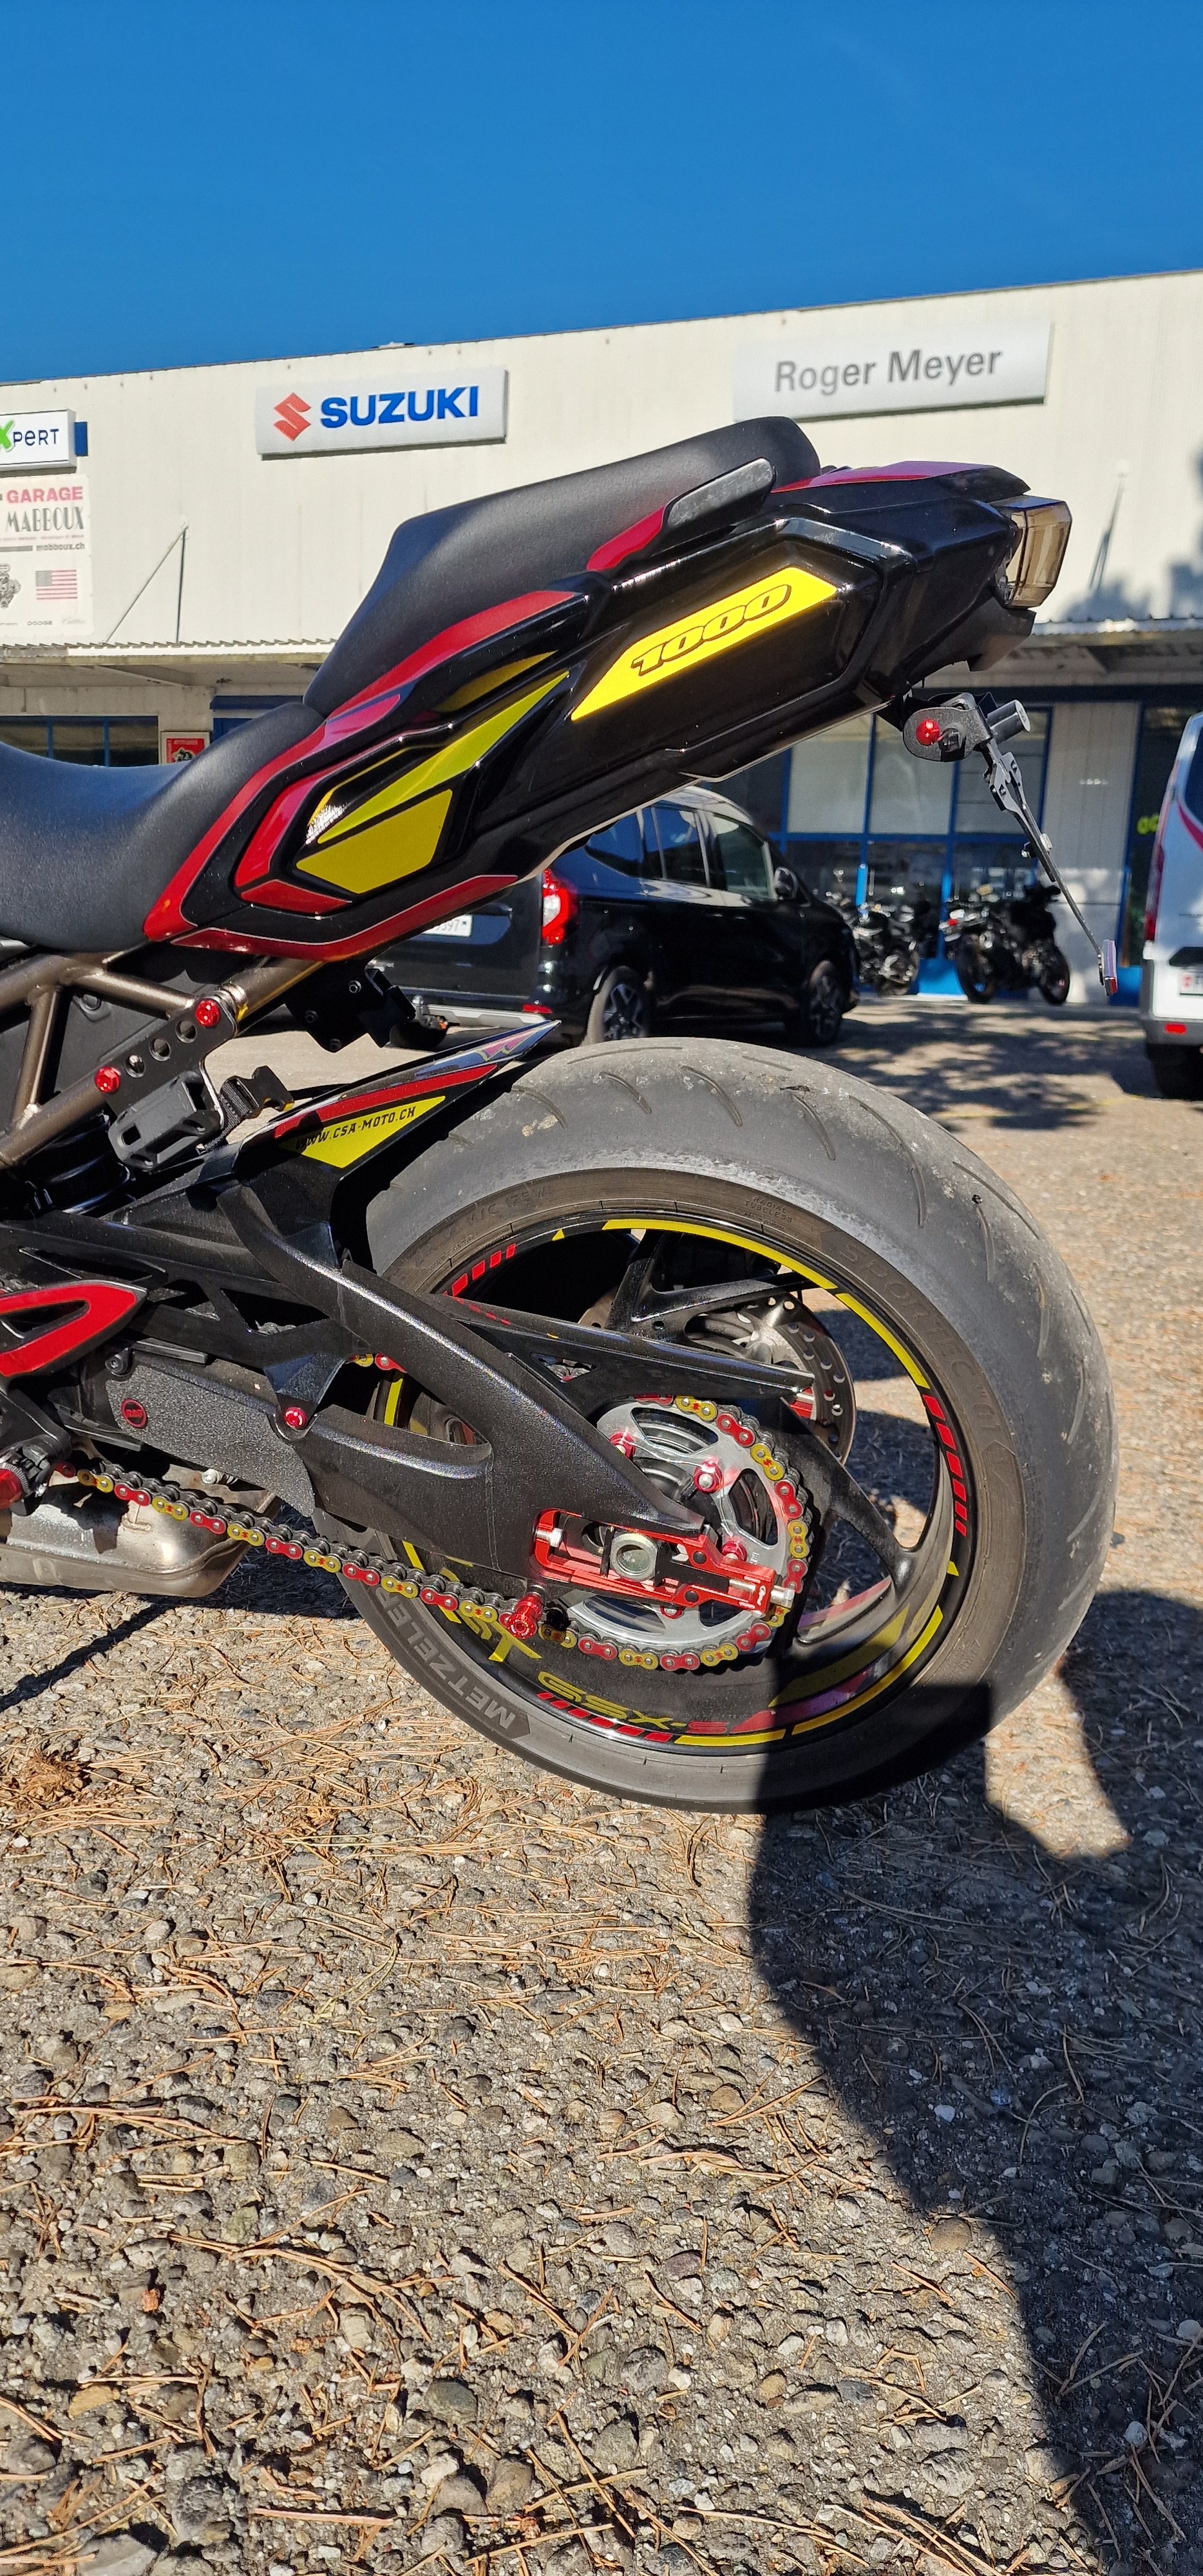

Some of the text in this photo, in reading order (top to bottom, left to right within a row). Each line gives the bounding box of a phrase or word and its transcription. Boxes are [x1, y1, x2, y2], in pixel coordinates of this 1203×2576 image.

[774, 348, 1003, 396] Roger Meyer
[321, 386, 479, 429] SUZUKI
[6, 486, 83, 504] GARAGE
[5, 506, 84, 533] MABBOUX
[36, 542, 85, 551] mabboux.ch
[630, 584, 791, 676] 1000
[375, 1586, 516, 1730] METZELER
